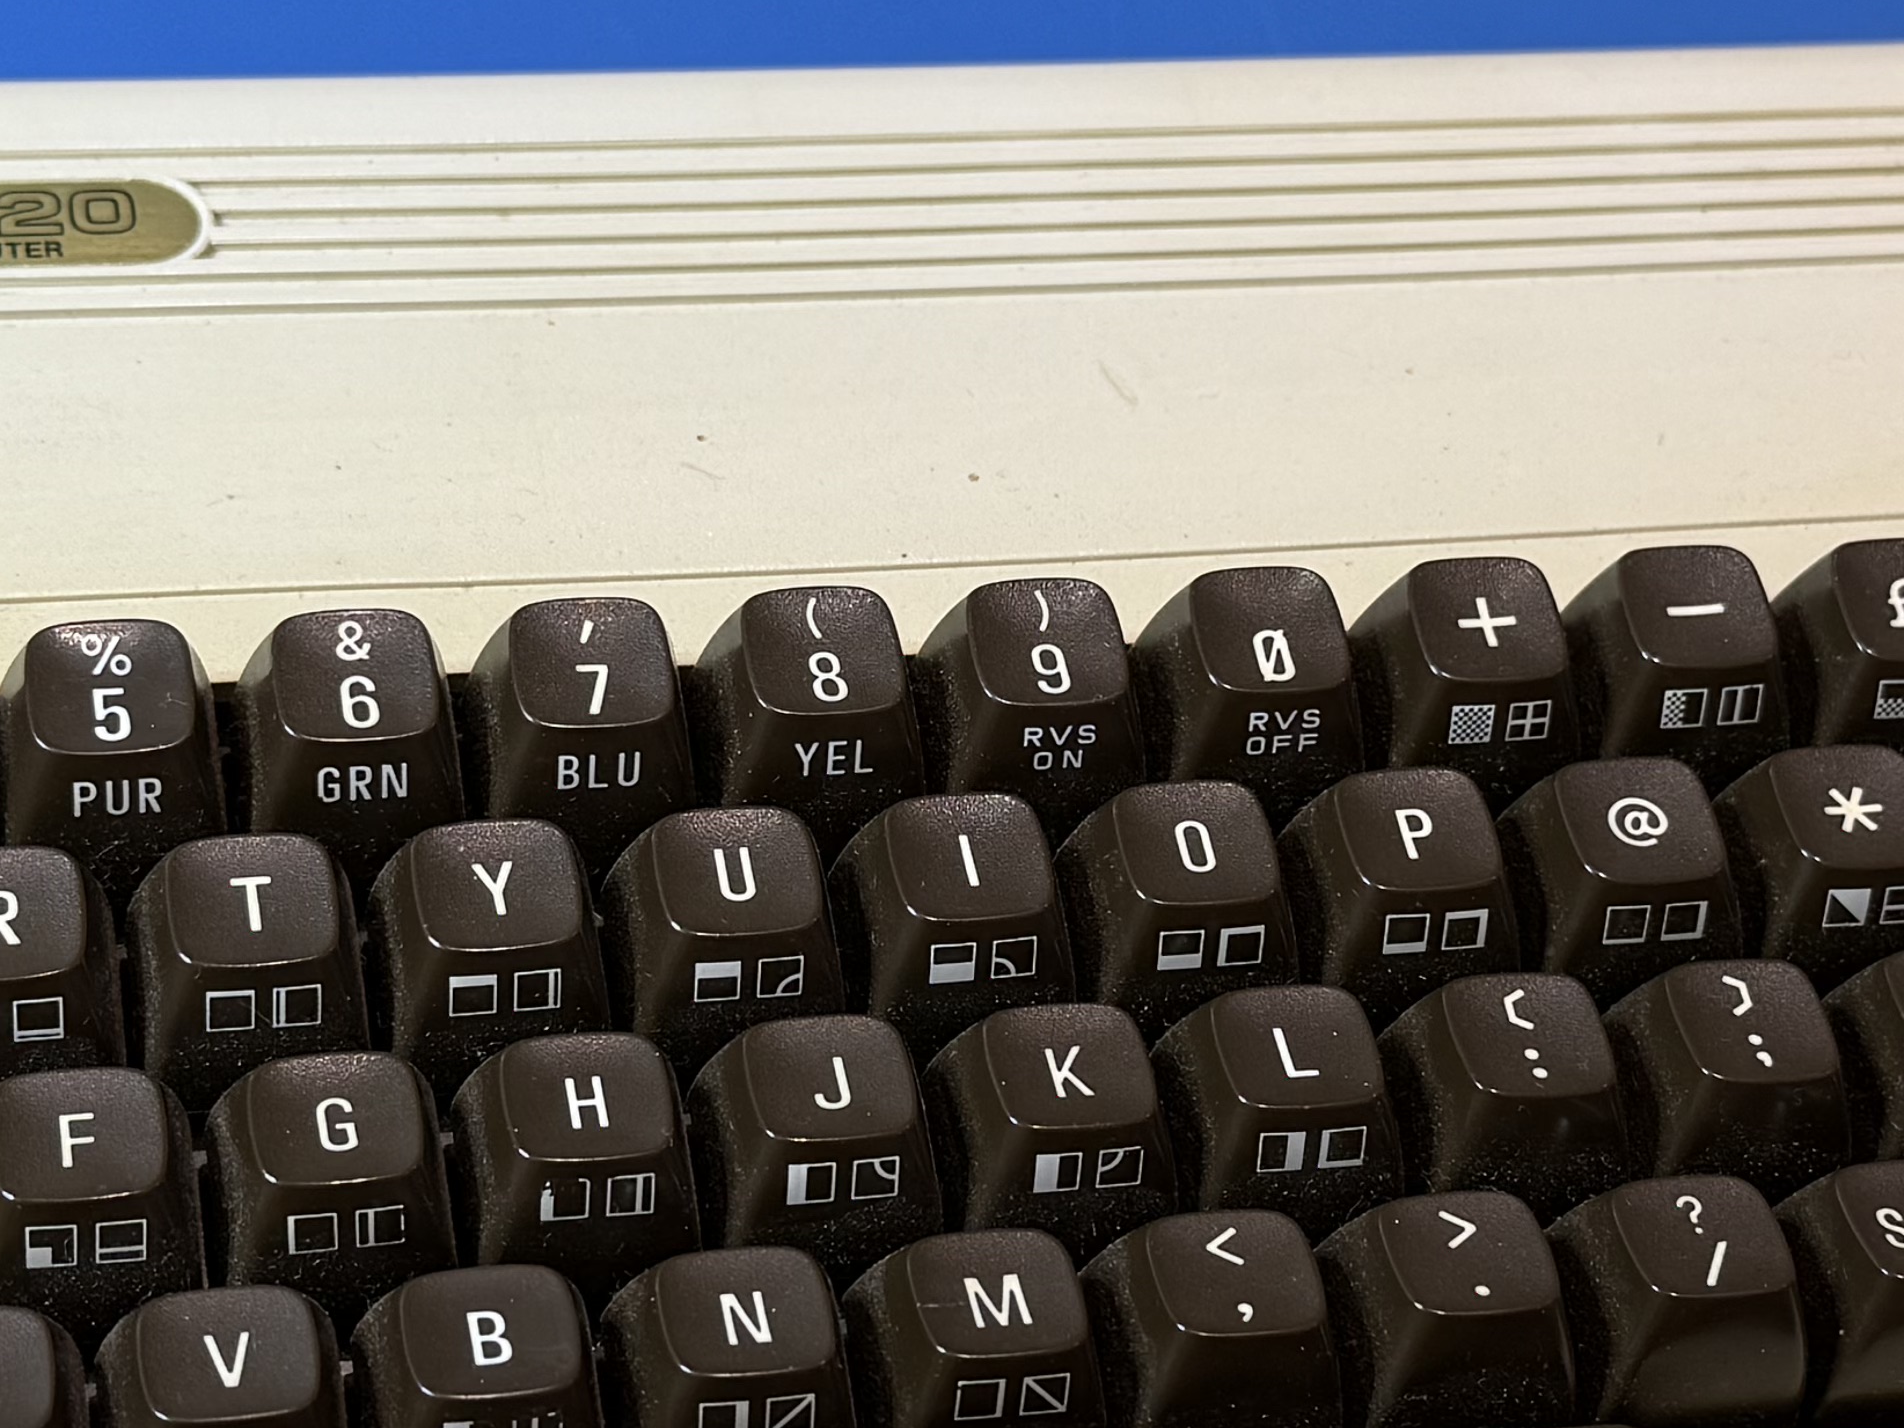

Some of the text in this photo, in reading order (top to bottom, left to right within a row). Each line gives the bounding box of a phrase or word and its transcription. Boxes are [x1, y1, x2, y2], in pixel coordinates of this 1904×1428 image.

[805, 597, 823, 639] (
[1033, 589, 1050, 632] )
[1457, 597, 1517, 647] +
[79, 630, 133, 676] %
[335, 620, 371, 661] &
[575, 664, 609, 715] 7
[808, 651, 849, 702] 8
[1031, 643, 1071, 694] 9
[92, 687, 132, 742] 5
[339, 675, 380, 729] 6
[1248, 708, 1321, 732] RVS
[794, 739, 874, 777] YEL
[1023, 724, 1096, 747] RVS
[1033, 749, 1084, 771] ON
[1246, 733, 1319, 755] OFF
[317, 762, 408, 803] GRN
[557, 751, 641, 790] BLU
[72, 777, 162, 818] PUR
[1607, 797, 1669, 847] @
[1394, 808, 1433, 860] P
[713, 846, 757, 902] U
[958, 834, 980, 887] I
[229, 875, 272, 932] T
[471, 860, 513, 916] Y
[1044, 1045, 1095, 1098] K
[1272, 1027, 1320, 1078] L
[564, 1075, 609, 1130] H
[814, 1056, 851, 1110] J
[58, 1112, 95, 1168] F
[315, 1097, 359, 1152] G
[1438, 1210, 1477, 1249] >
[1675, 1195, 1704, 1235] ?
[1205, 1227, 1245, 1266] <
[1706, 1240, 1728, 1287] /
[719, 1290, 773, 1346] N
[963, 1273, 1033, 1329] M
[203, 1331, 250, 1388] V
[466, 1310, 513, 1366] B
